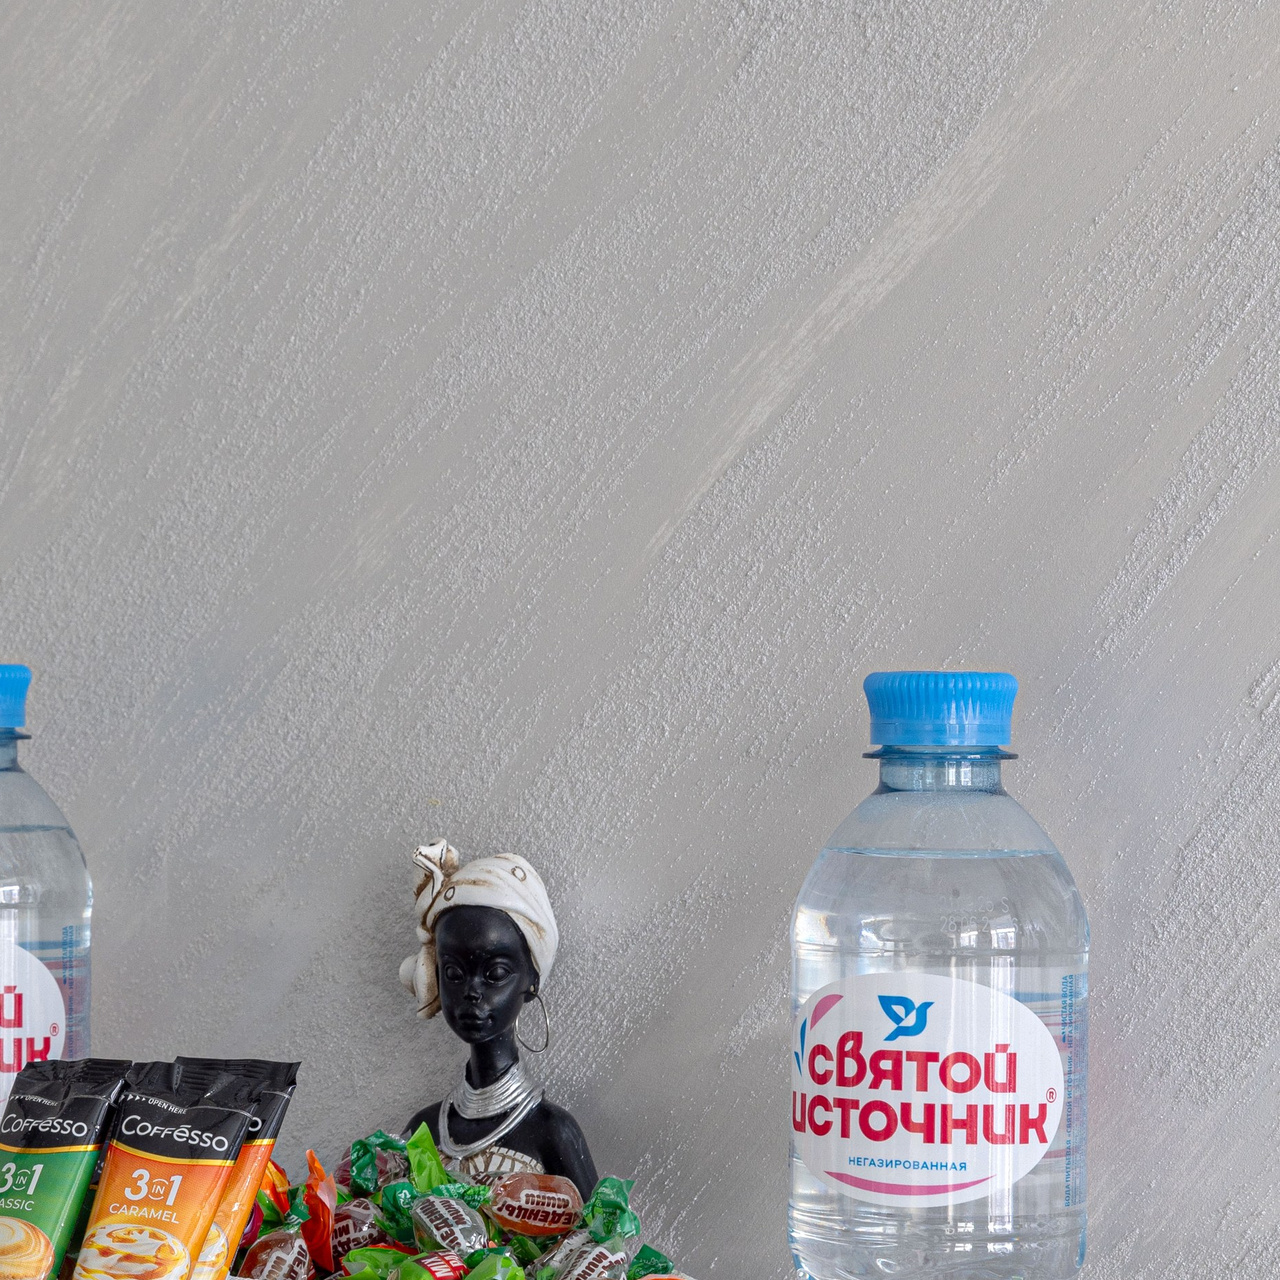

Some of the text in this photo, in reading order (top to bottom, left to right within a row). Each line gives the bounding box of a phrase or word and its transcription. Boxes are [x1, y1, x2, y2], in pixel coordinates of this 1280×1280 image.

[808, 1031, 1017, 1094] СВЯТОЙ
[148, 1097, 187, 1115] OPEN HERE
[792, 1090, 1048, 1145] ИСТОЧНИК
[848, 1156, 967, 1172] НЕГАЗИРОВАННАЯ
[109, 1203, 180, 1224] CARAMEL
[419, 1198, 462, 1251] ЛЕДЕНЦ
